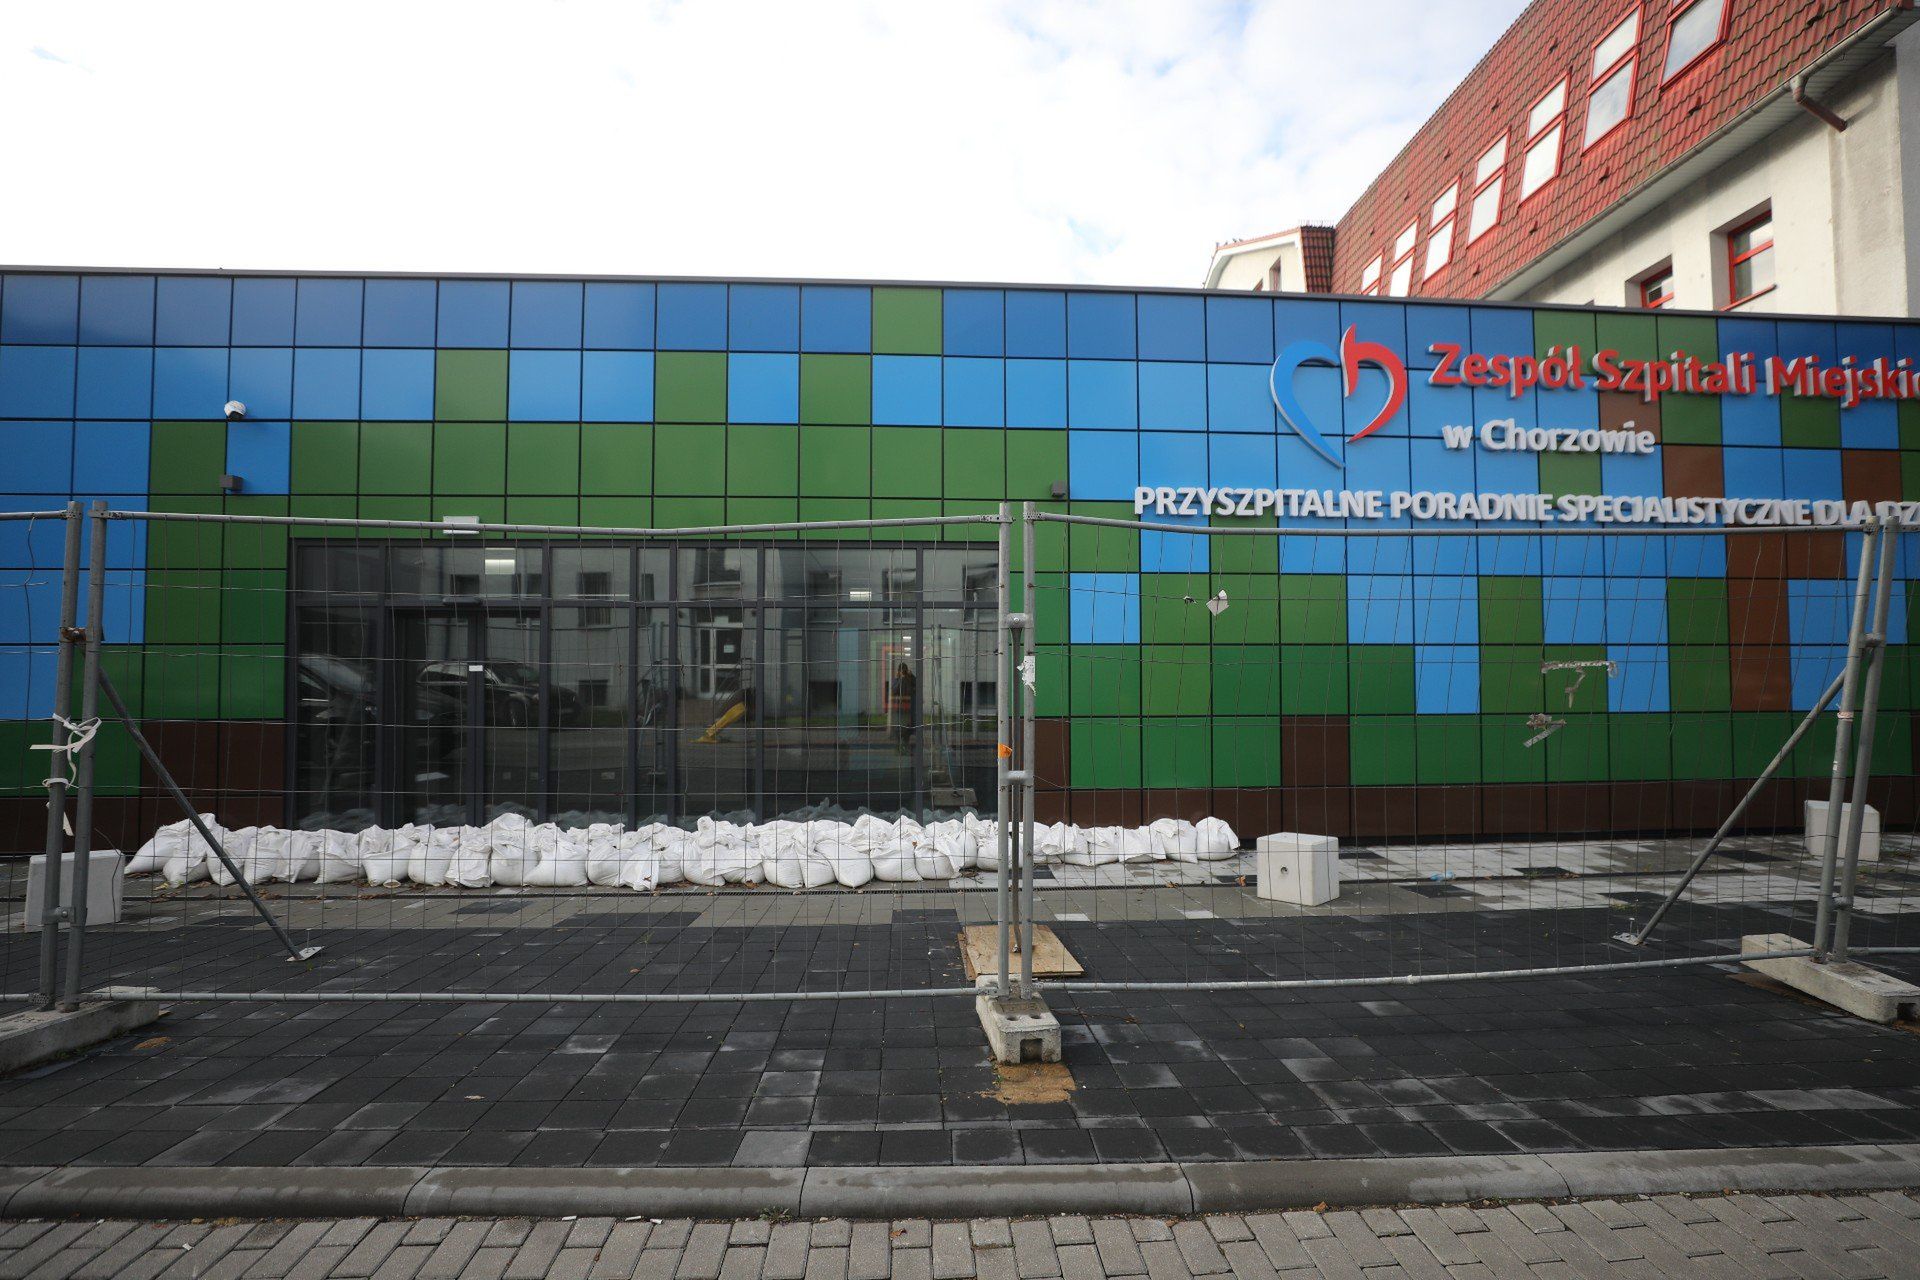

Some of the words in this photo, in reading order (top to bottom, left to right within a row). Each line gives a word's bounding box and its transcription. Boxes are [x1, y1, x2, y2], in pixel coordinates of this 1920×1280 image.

[1428, 343, 1585, 399] Zespół
[1592, 349, 1757, 402] Szpitali
[1441, 424, 1473, 449] w
[1480, 417, 1656, 454] Chorzowie
[1134, 486, 1384, 518] PRZYSZPITALNE
[1390, 491, 1554, 521] PORADNIE
[1557, 494, 1811, 525] SPECIALISTYCZNE
[1813, 499, 1873, 526] DLA
